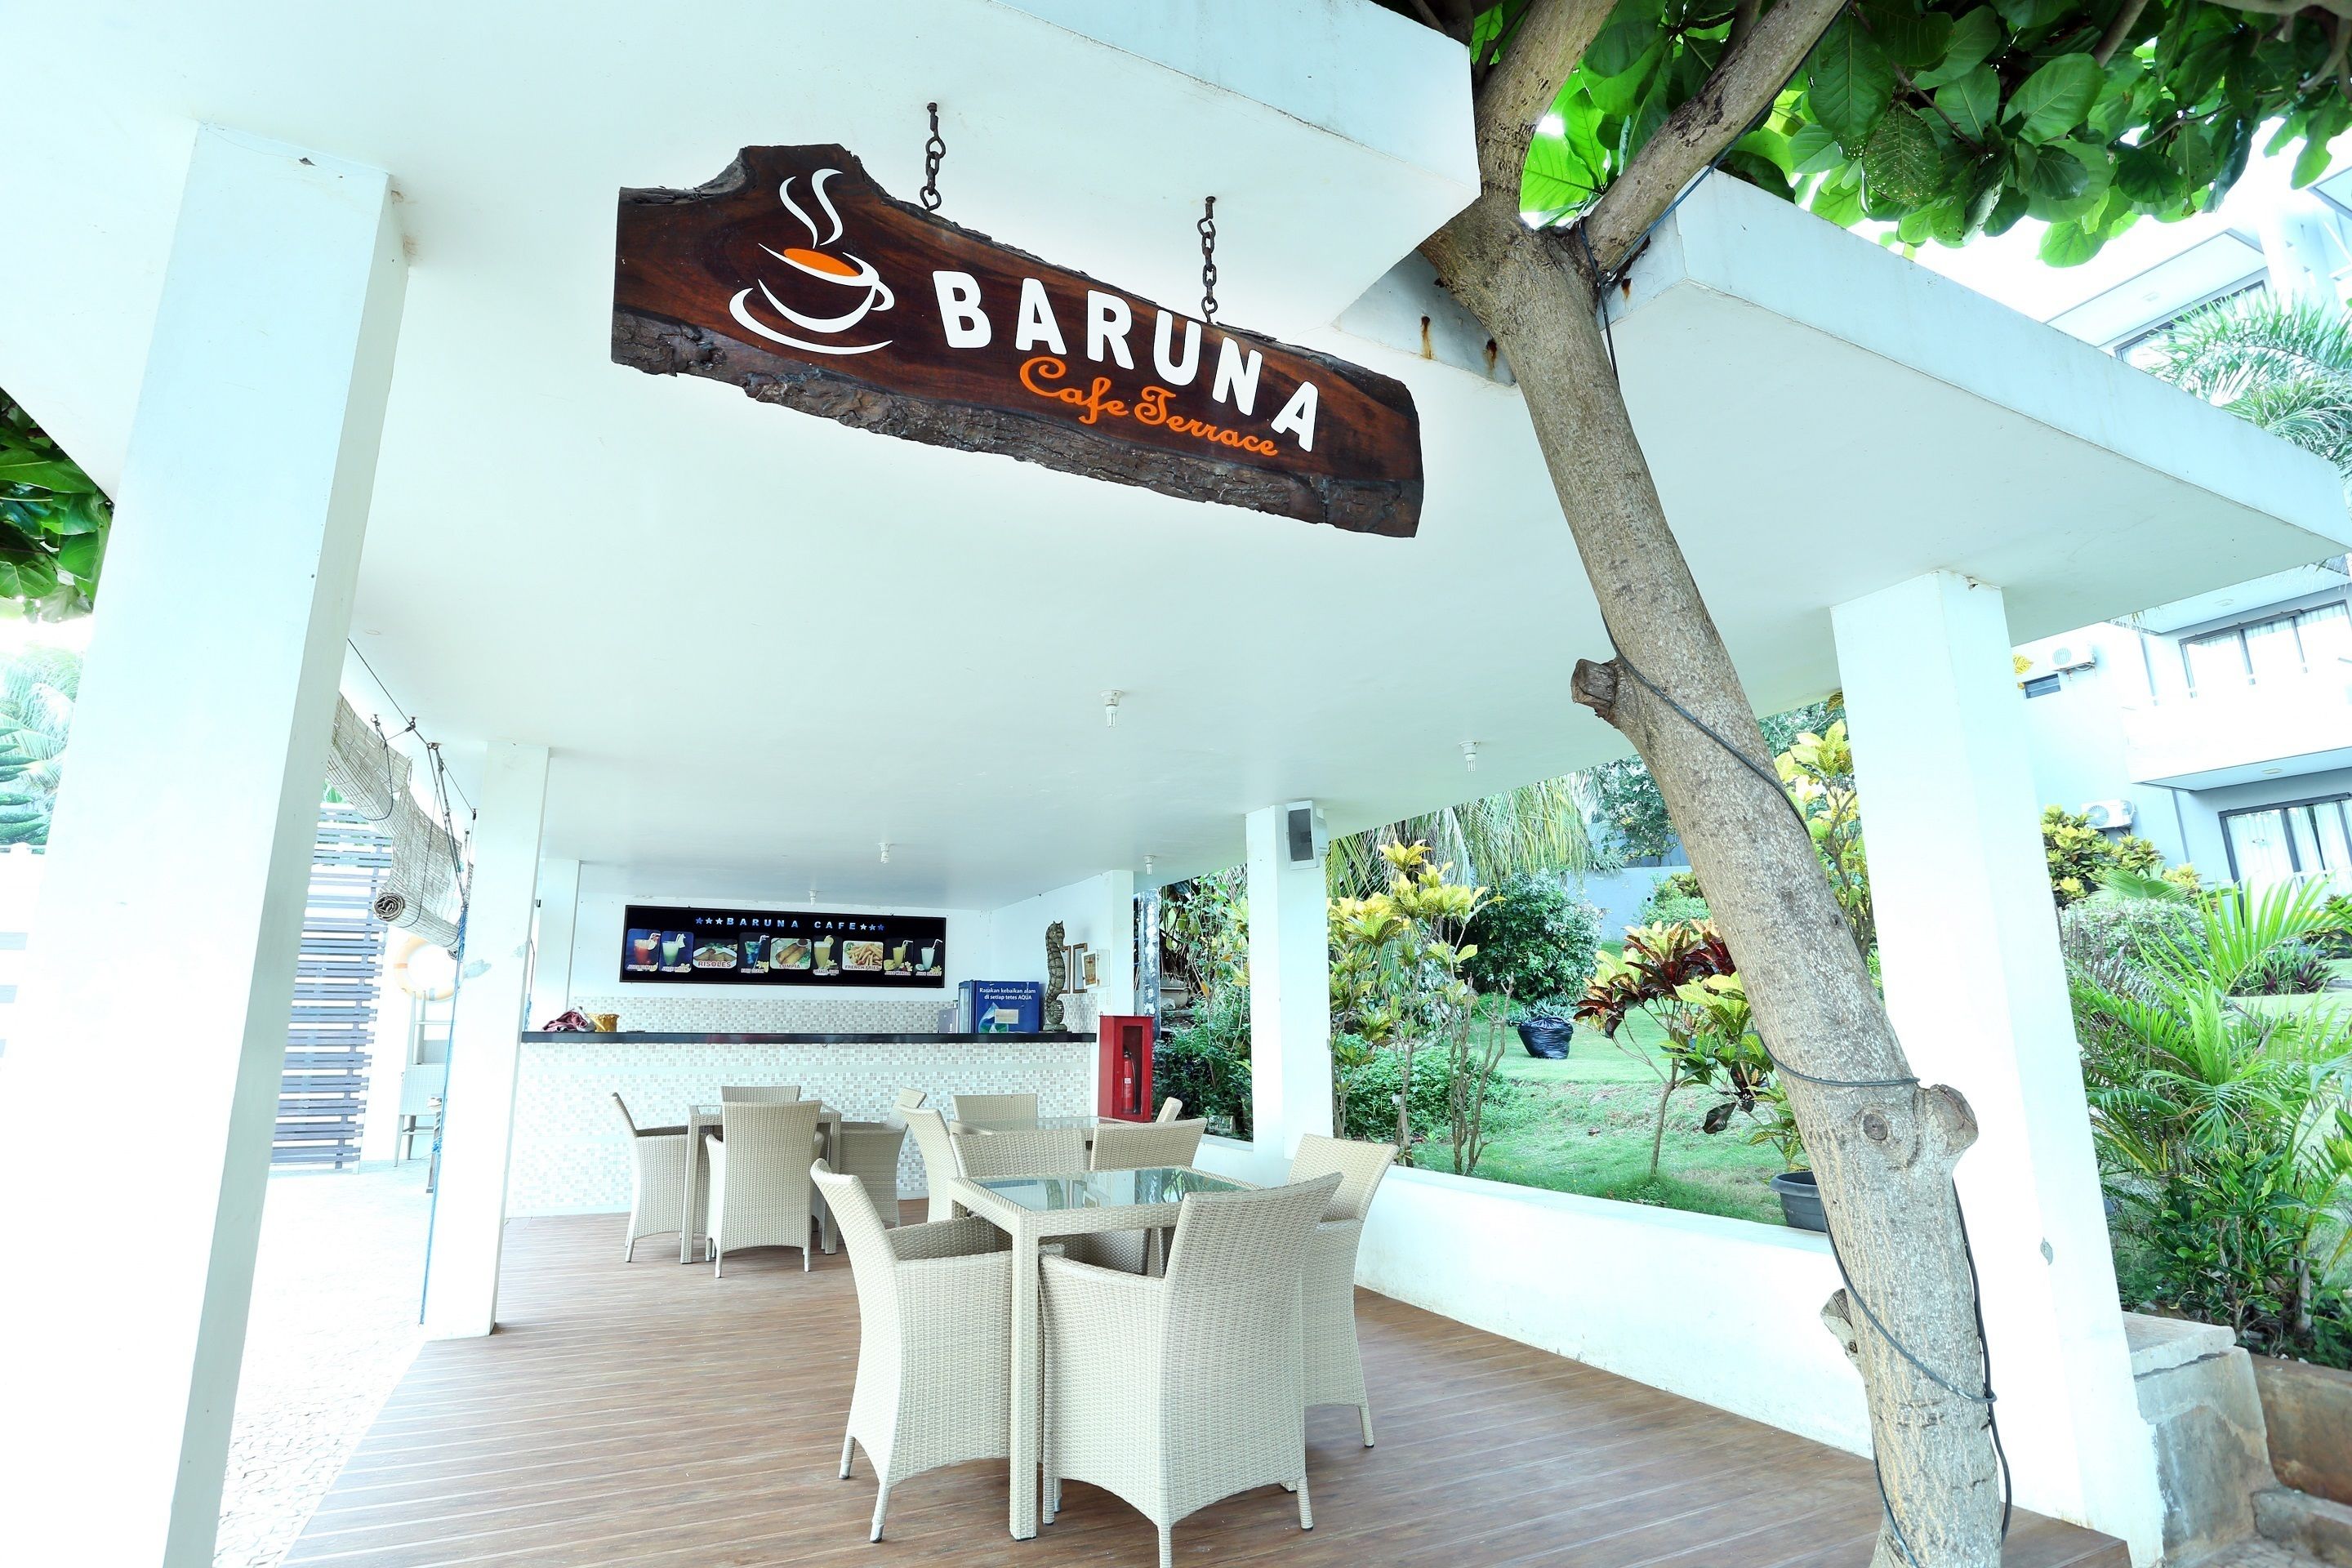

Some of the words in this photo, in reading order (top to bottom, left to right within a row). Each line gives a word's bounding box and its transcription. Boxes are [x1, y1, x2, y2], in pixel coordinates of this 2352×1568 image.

[932, 270, 1320, 453] BARUNA
[1020, 356, 1129, 425] Cafe
[1134, 385, 1278, 457] Terrace
[726, 917, 800, 929] BARUNA
[813, 920, 856, 930] CAFE
